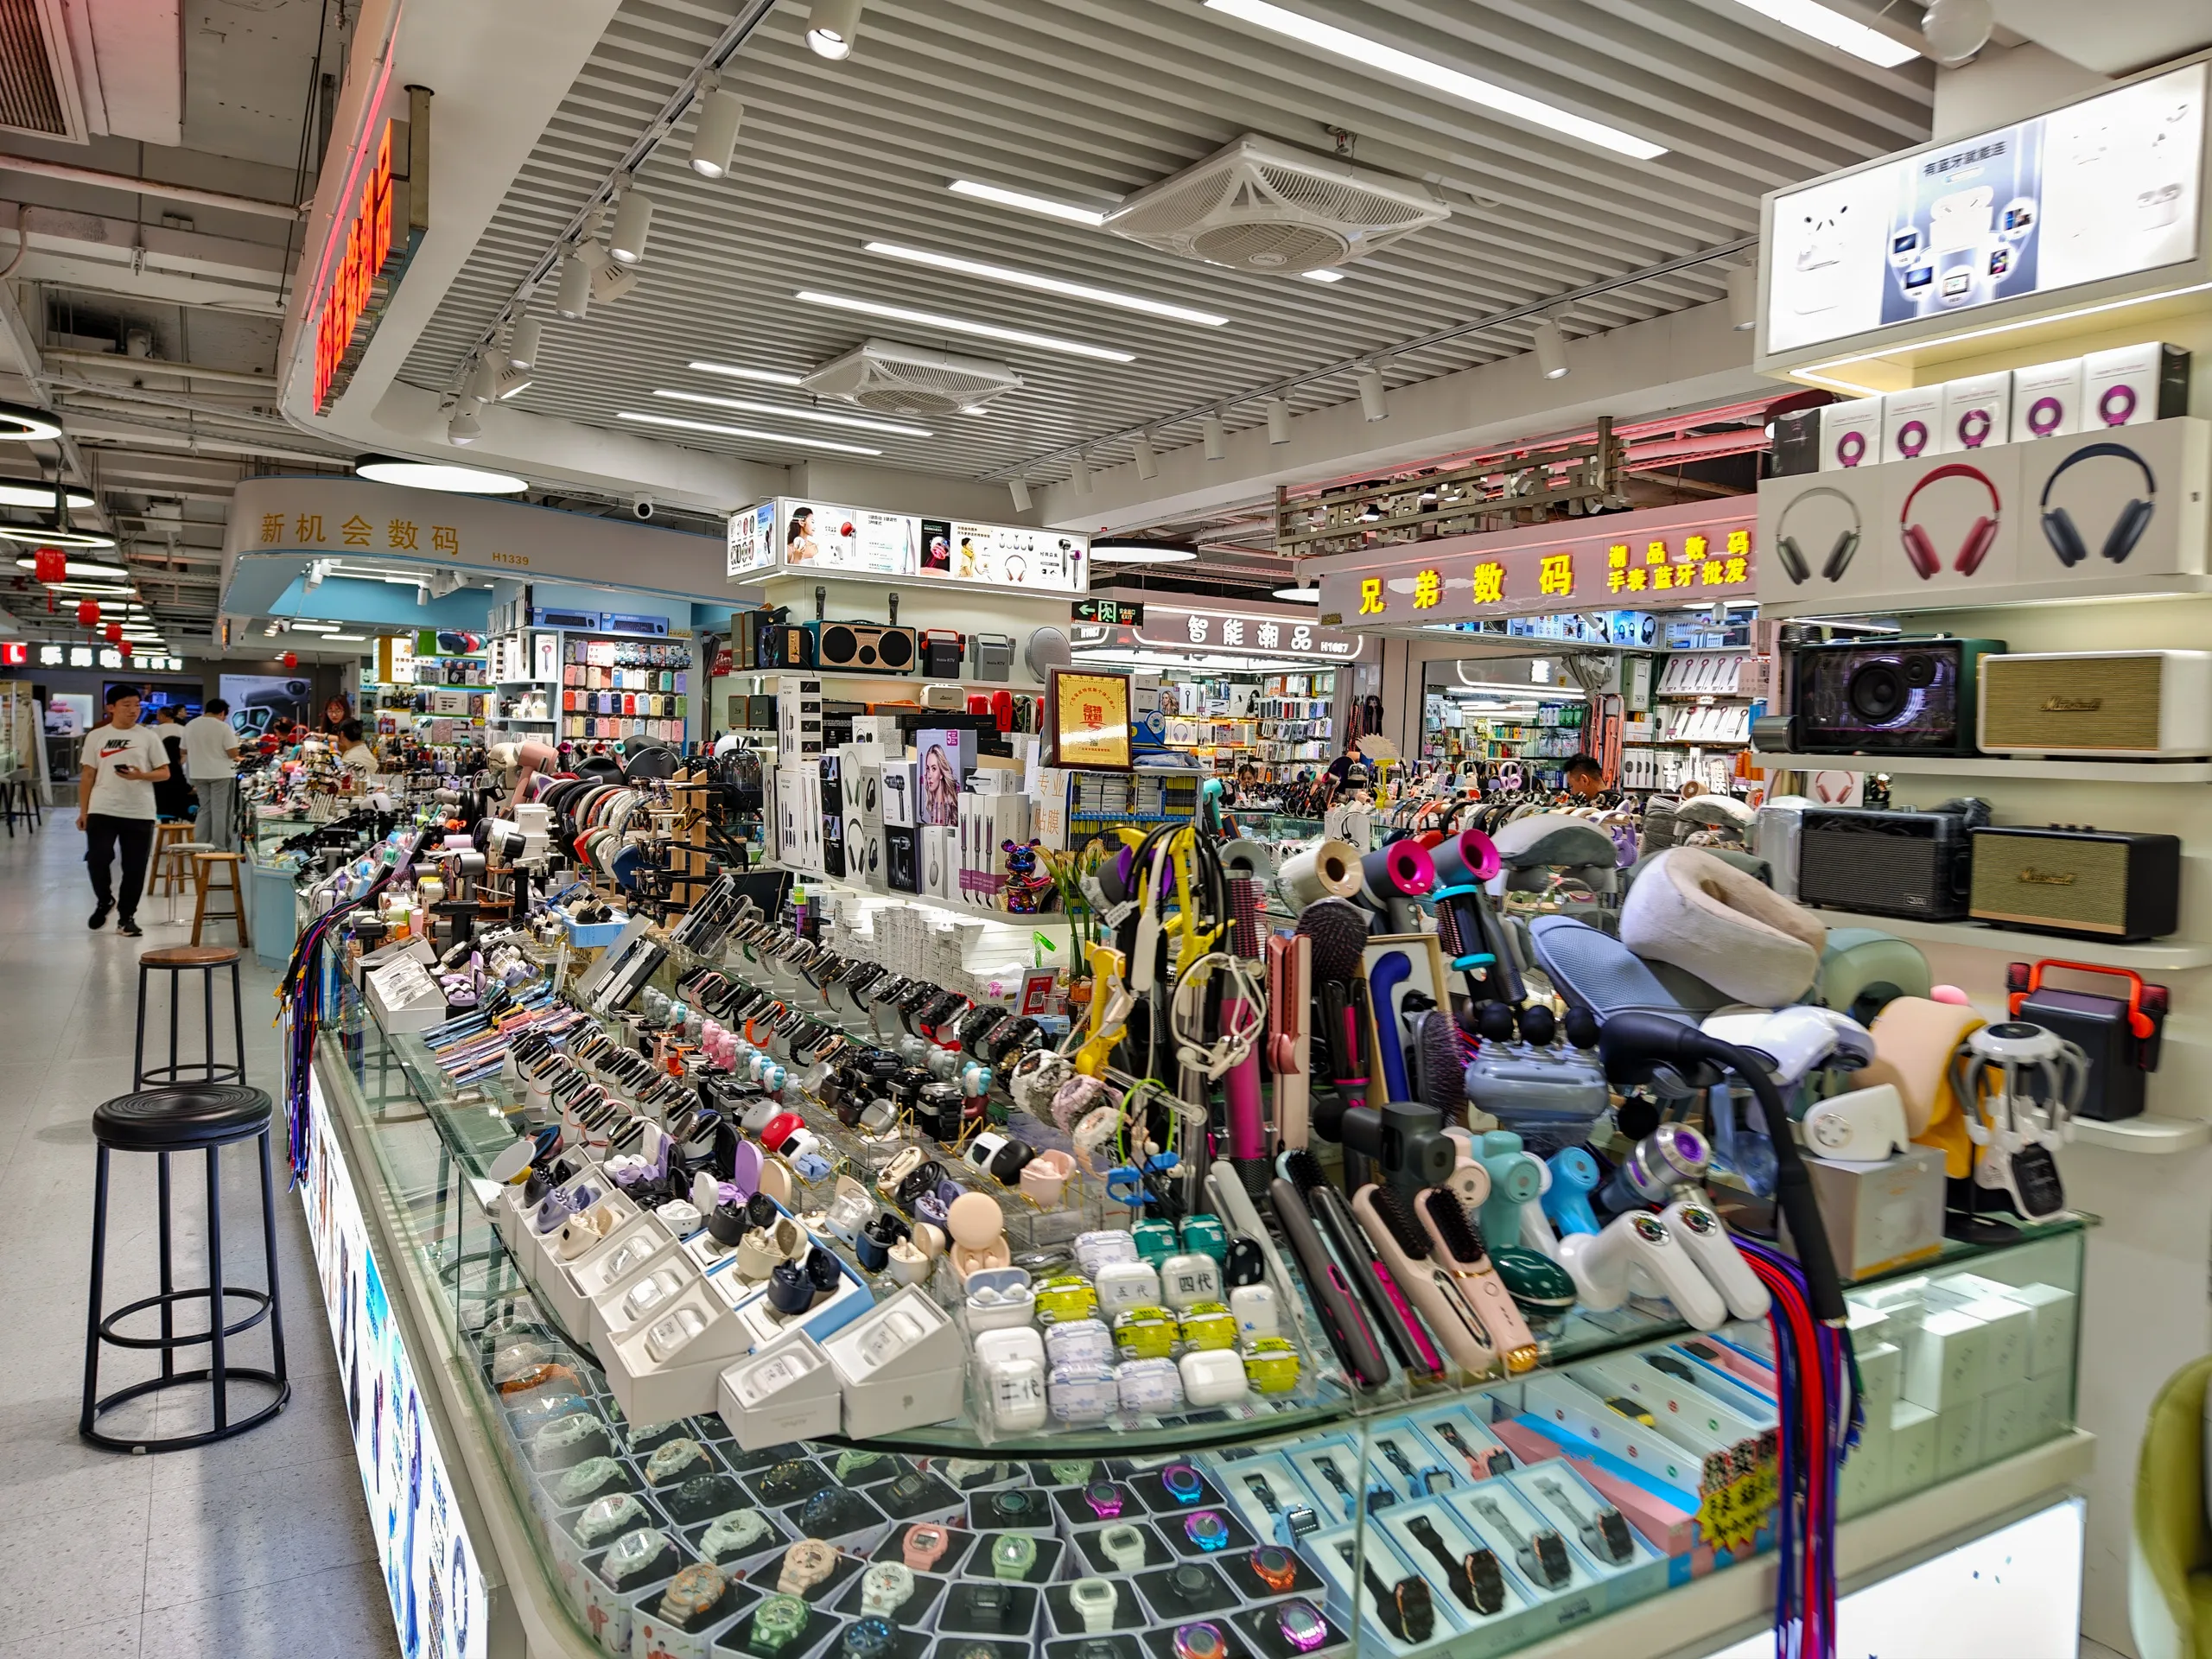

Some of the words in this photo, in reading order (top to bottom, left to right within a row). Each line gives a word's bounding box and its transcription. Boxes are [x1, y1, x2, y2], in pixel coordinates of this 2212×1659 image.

[261, 512, 460, 556] 新机会数码
[492, 551, 530, 566] H1339
[1608, 530, 1751, 569] 潮品数码
[1358, 554, 1574, 616] 兄弟数码
[1606, 557, 1750, 594] 手表蓝牙批发
[1187, 614, 1313, 651] 智能潮品
[105, 739, 132, 749] NIKE
[1037, 772, 1064, 798] 专业
[1033, 807, 1060, 836] 贴膜
[1179, 1273, 1214, 1293] 四代
[1001, 1376, 1041, 1400] 二代
